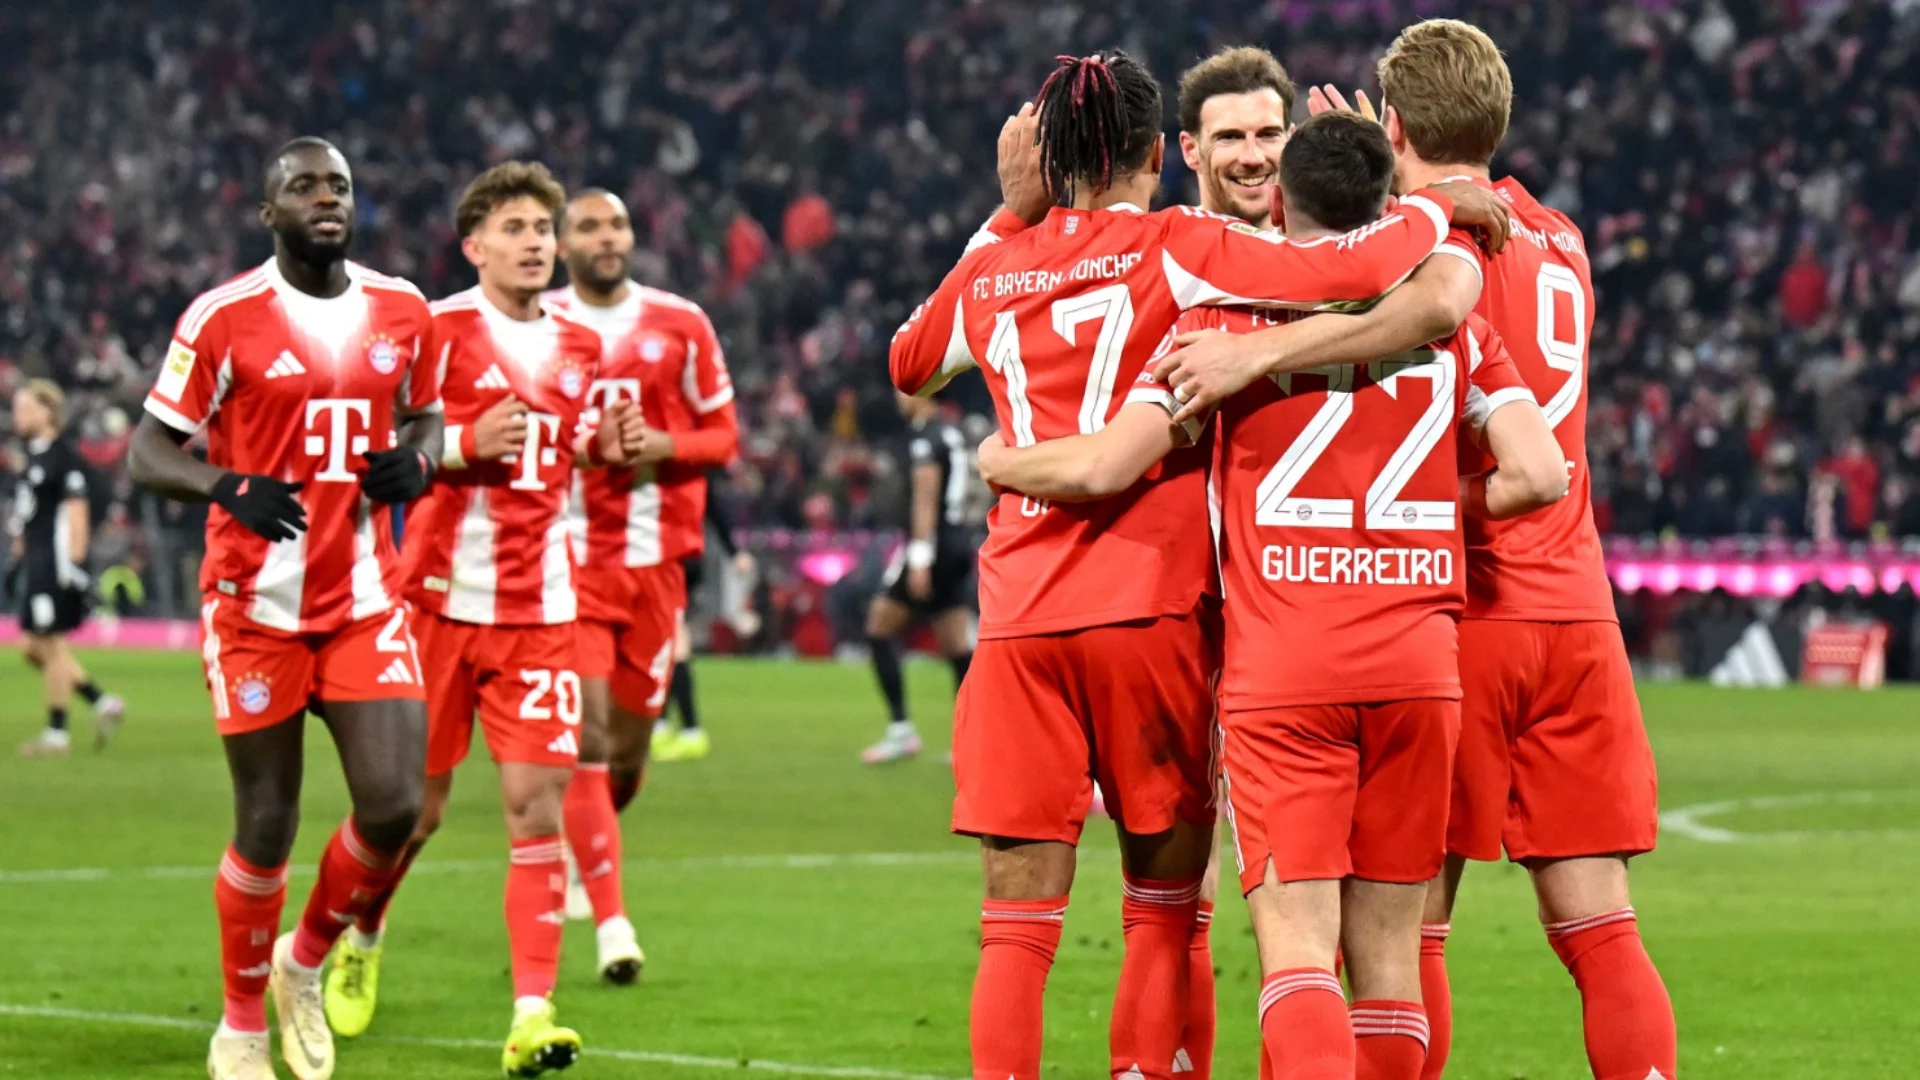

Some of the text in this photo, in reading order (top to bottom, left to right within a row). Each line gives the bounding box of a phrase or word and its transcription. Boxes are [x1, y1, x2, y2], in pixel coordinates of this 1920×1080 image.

[973, 277, 990, 300] FC
[994, 270, 1063, 297] BAYERN
[985, 283, 1135, 448] 17
[1536, 261, 1585, 431] 9
[1256, 350, 1456, 531] 22
[1262, 545, 1453, 585] GUERREIRO
[519, 668, 583, 726] 20
